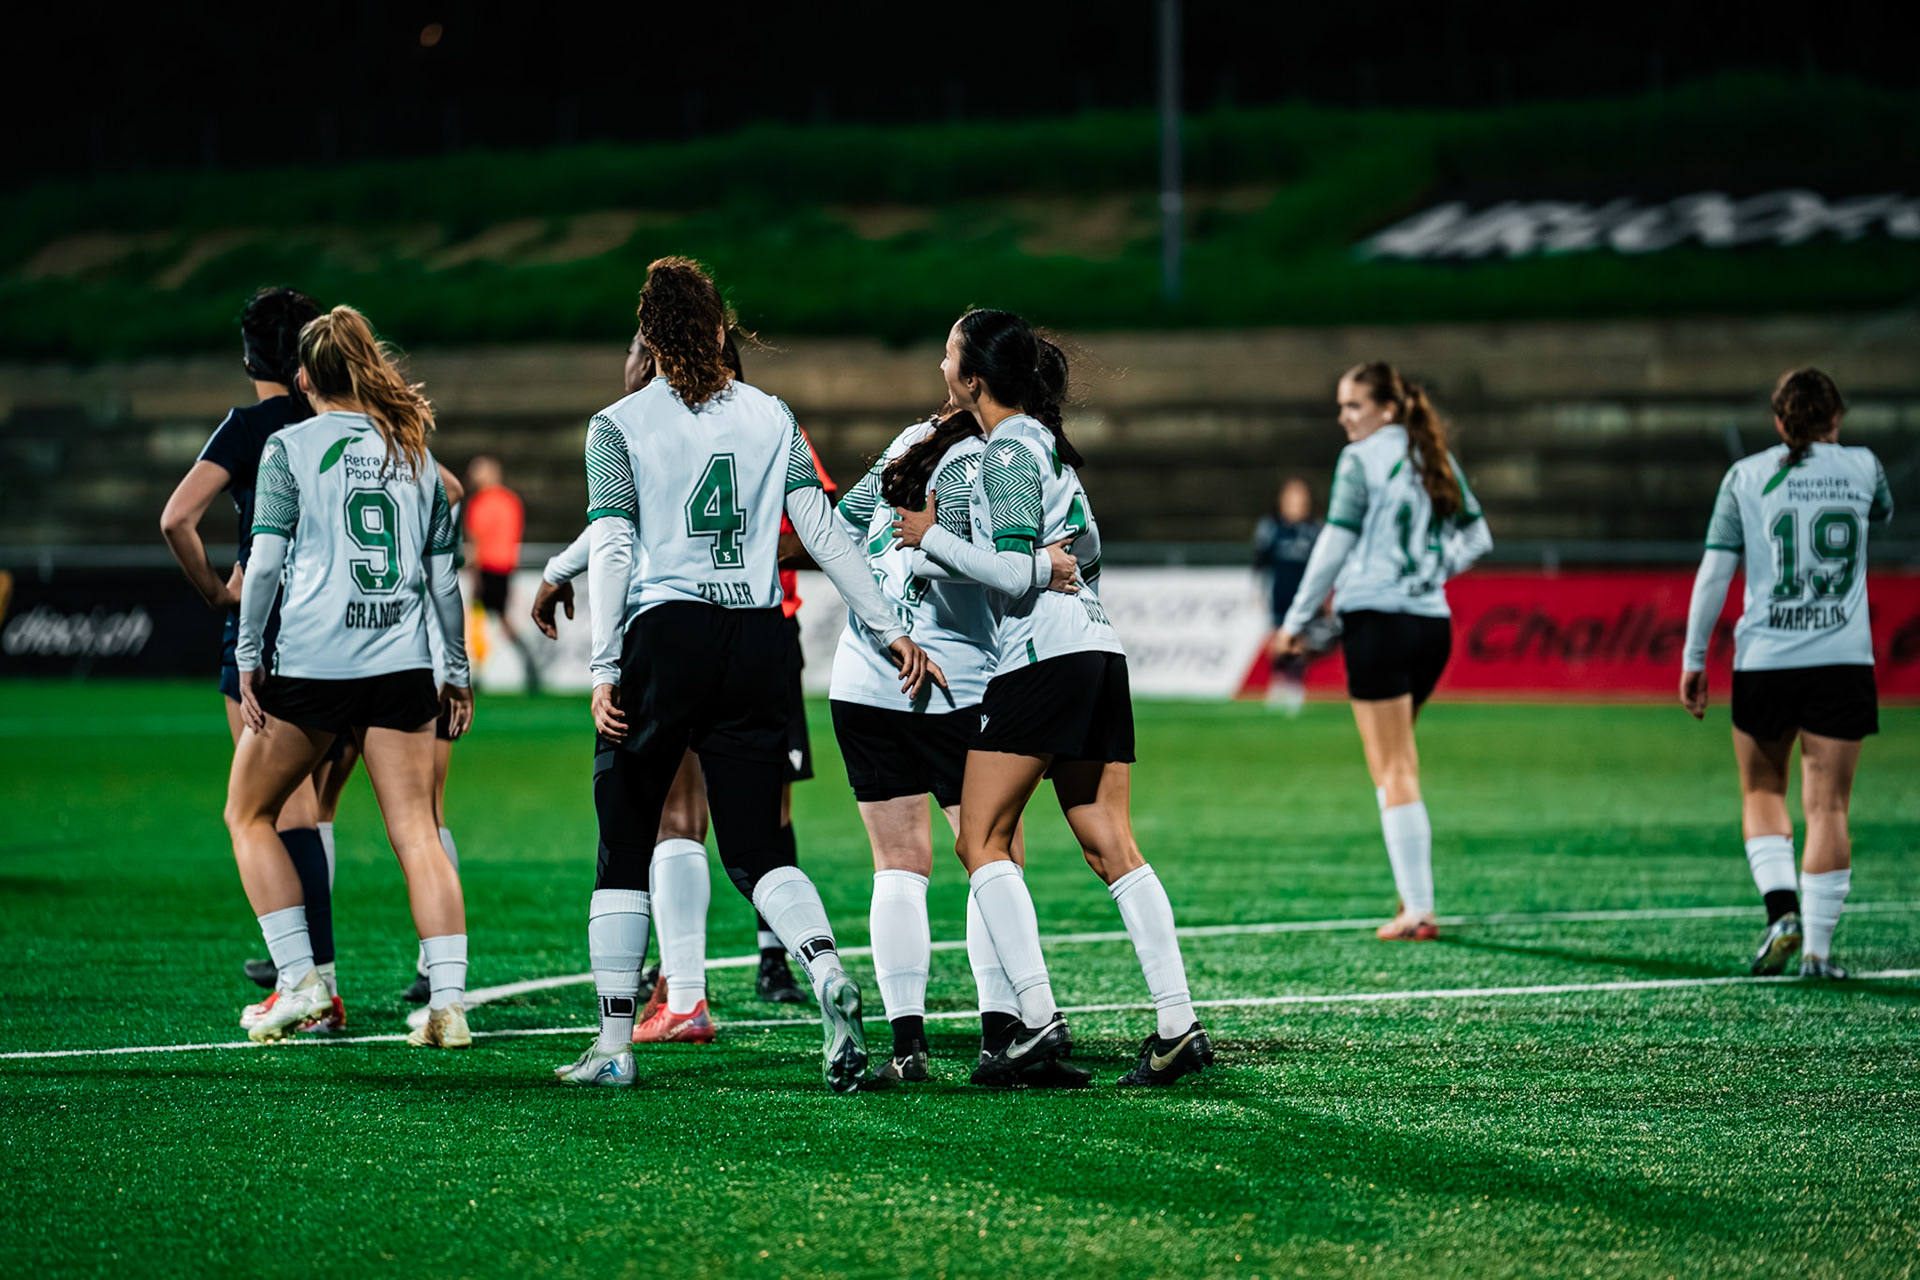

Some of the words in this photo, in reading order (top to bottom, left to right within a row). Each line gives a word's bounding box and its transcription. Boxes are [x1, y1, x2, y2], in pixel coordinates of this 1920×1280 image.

[344, 487, 403, 595] 9
[684, 453, 747, 569] 4
[1770, 506, 1862, 600] 19
[697, 582, 756, 605] ZELLER
